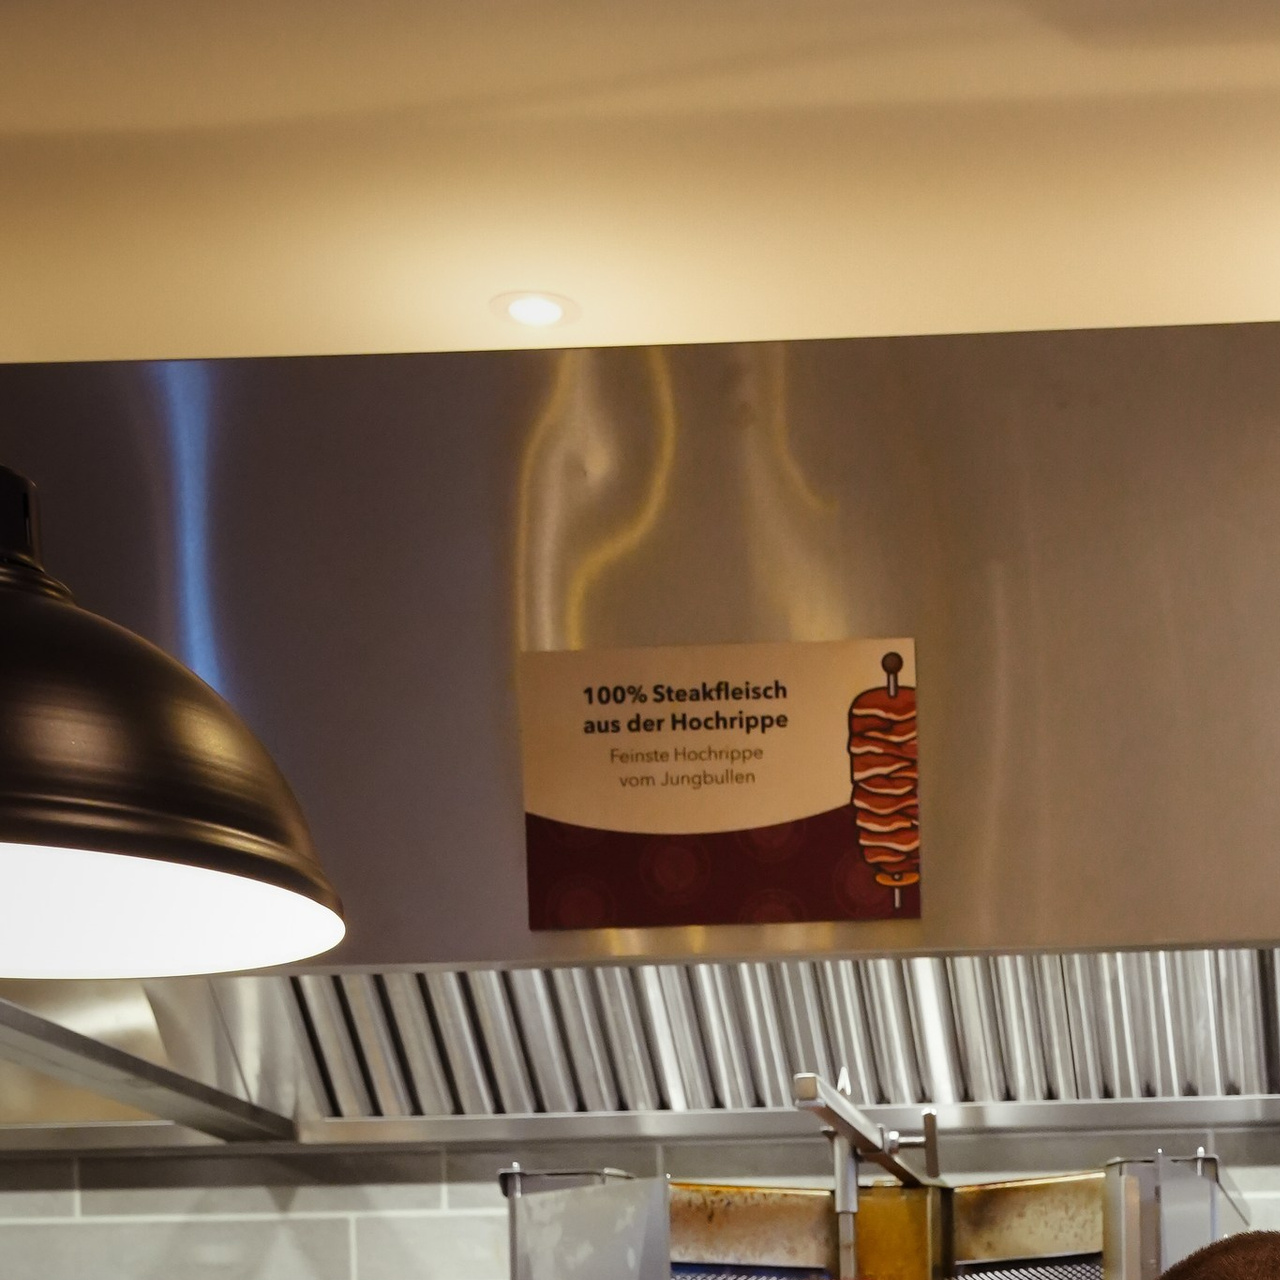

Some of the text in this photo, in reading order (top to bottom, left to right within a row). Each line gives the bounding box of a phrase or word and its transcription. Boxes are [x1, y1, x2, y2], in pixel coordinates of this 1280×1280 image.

[583, 680, 787, 705] 100% Steakfleisch
[583, 710, 789, 735] aus der Hochrippe
[610, 745, 764, 765] Feinste Hochrippe
[619, 769, 756, 790] vom Jungbullen
